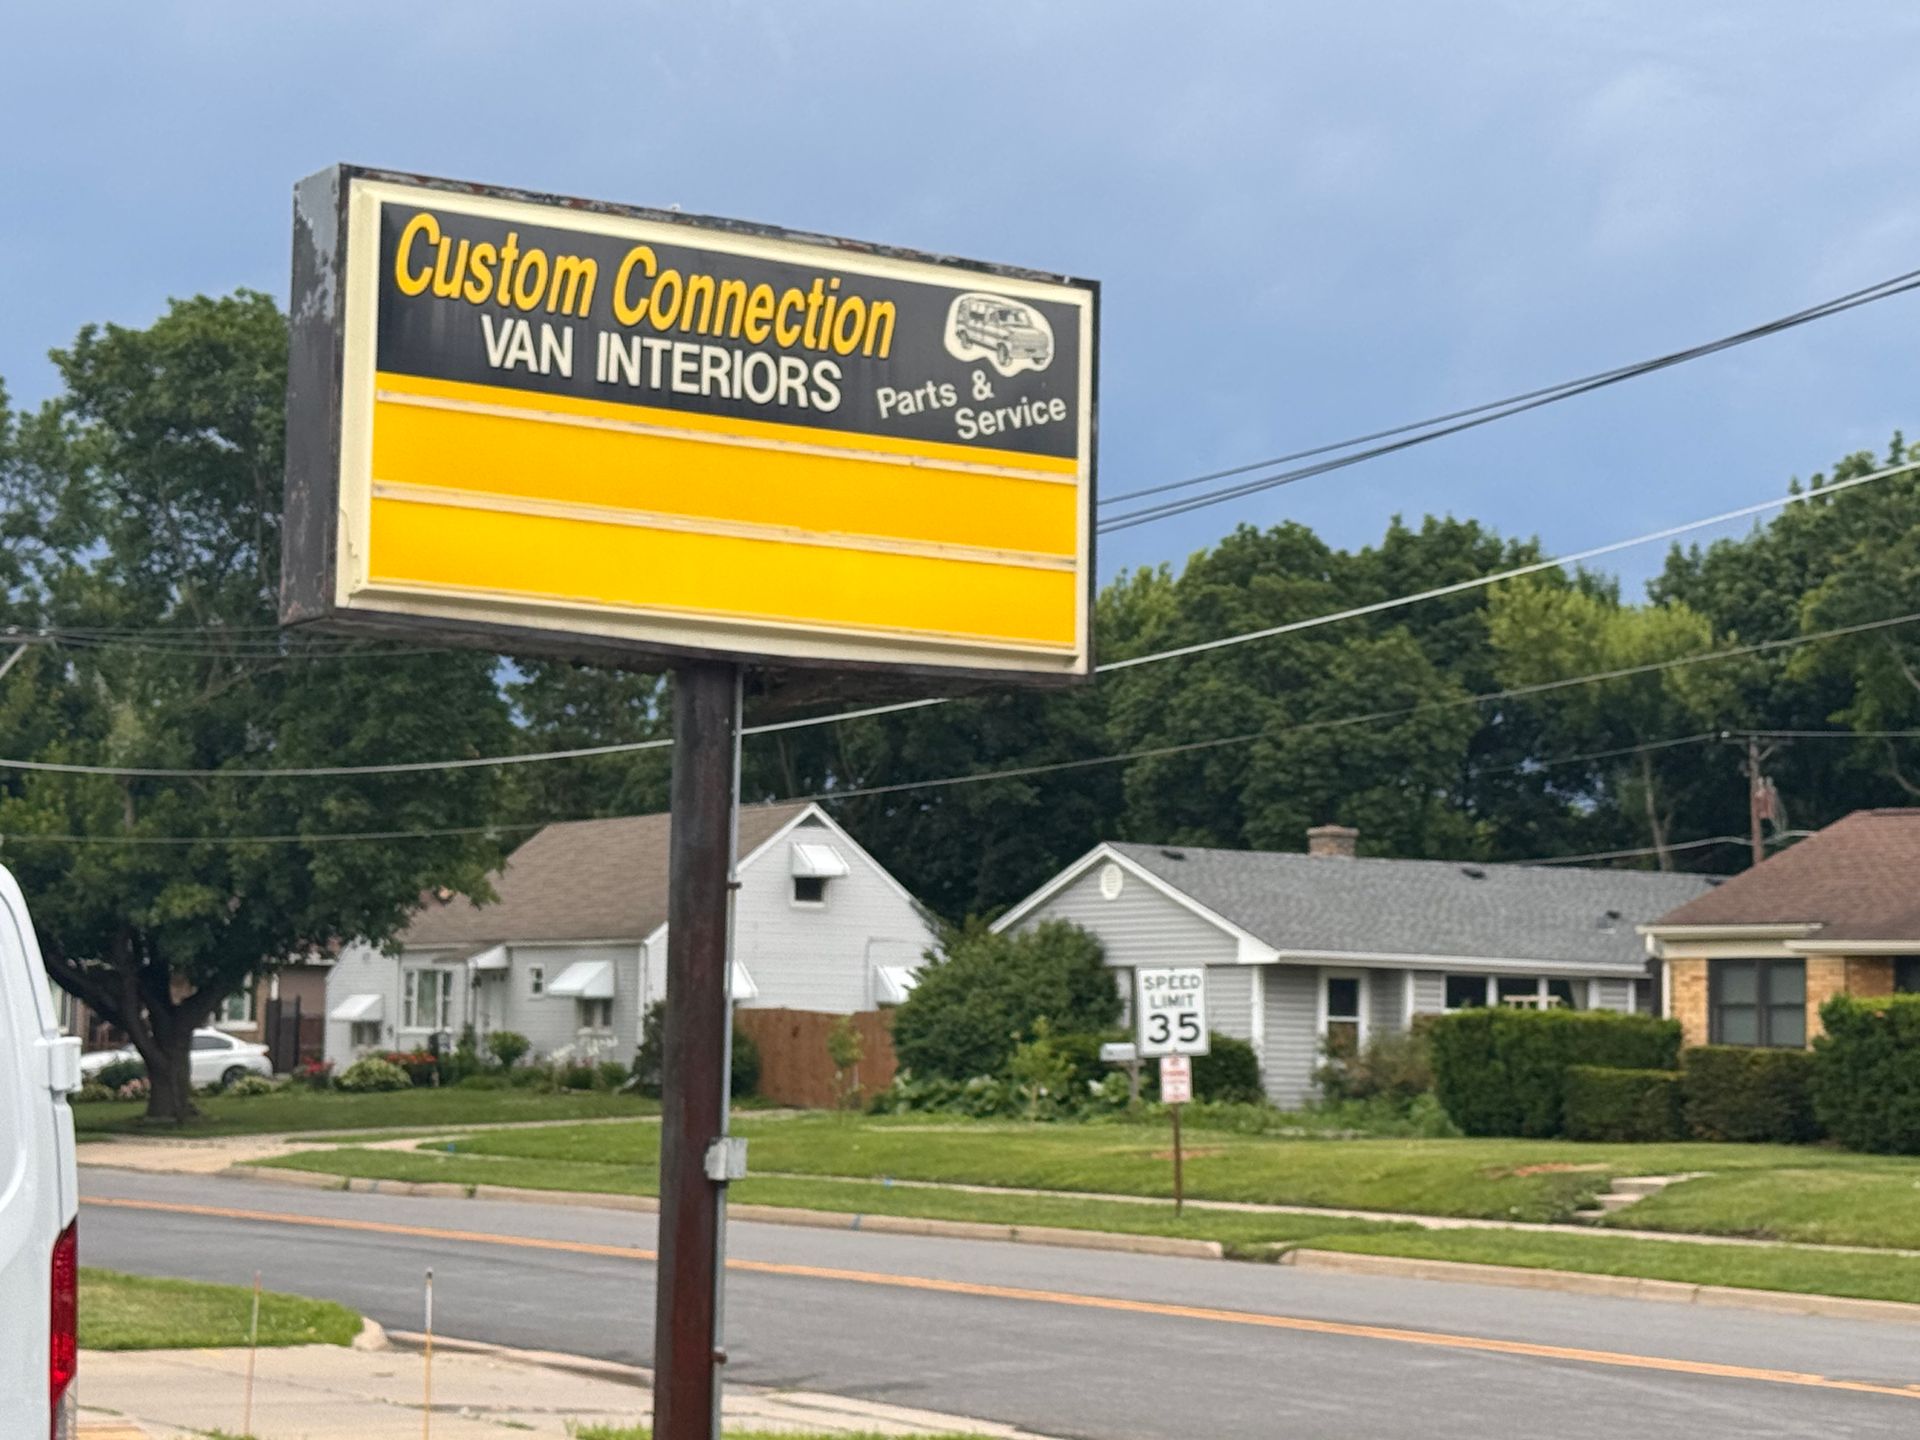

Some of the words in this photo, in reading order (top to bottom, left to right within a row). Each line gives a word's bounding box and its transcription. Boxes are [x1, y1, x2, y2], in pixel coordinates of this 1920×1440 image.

[395, 212, 599, 318] Custom
[613, 245, 897, 359] Connection
[481, 313, 574, 378] VAN
[596, 330, 843, 413] INTERIORS
[876, 380, 958, 419] Parts
[971, 369, 995, 401] &
[954, 396, 1067, 440] Service
[1144, 975, 1201, 991] SPEED
[1150, 993, 1195, 1009] LIMIT
[1149, 1013, 1201, 1044] 35
